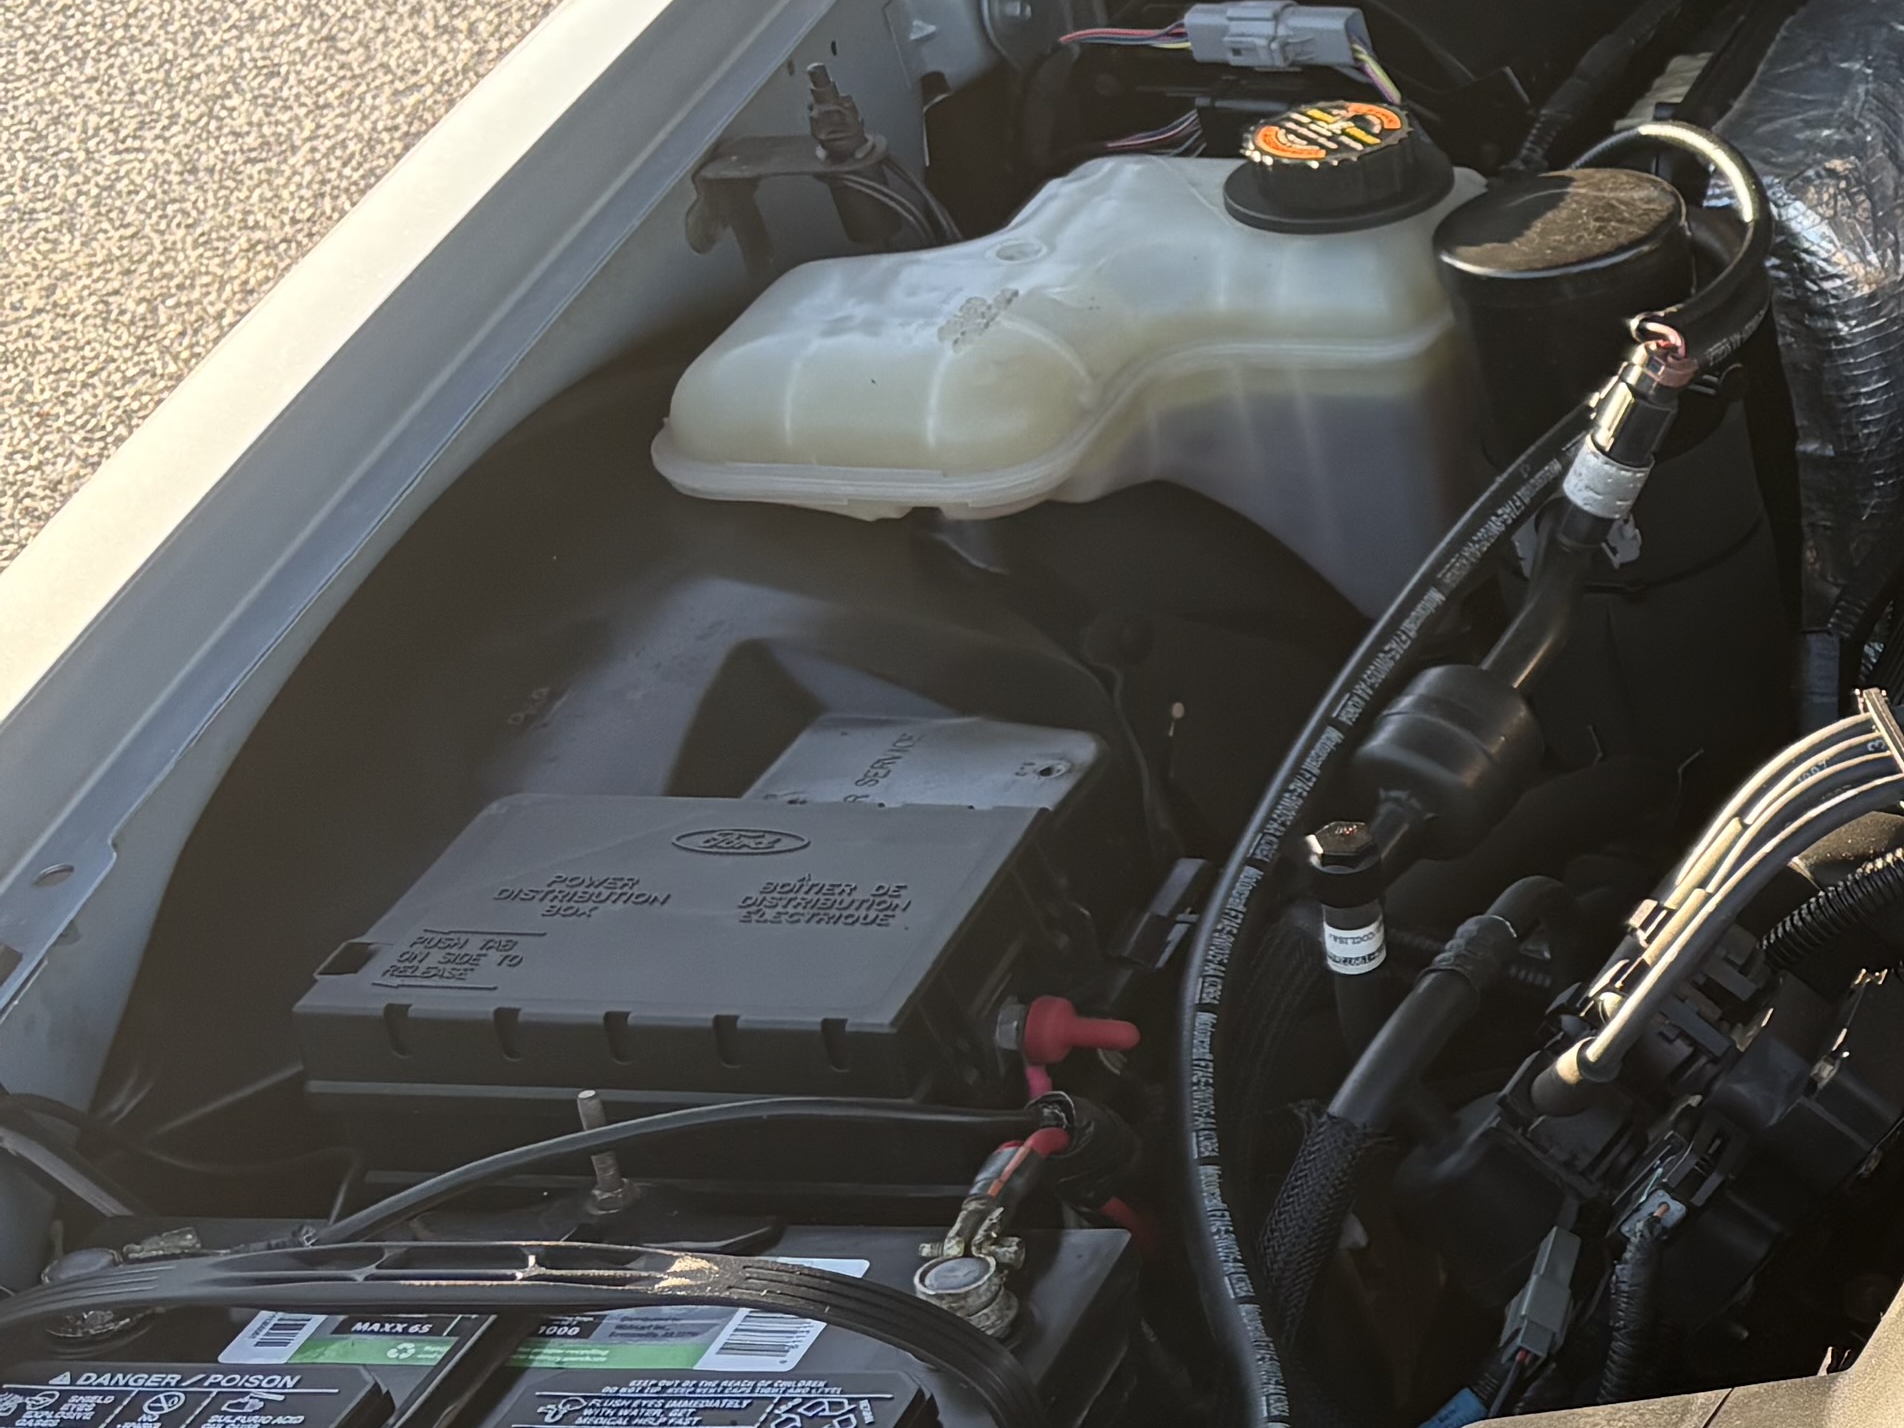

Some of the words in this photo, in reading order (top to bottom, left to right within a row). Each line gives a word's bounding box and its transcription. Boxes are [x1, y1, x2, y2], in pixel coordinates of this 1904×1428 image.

[545, 874, 641, 889] POWER
[491, 887, 673, 907] DISTRIBUTION
[869, 884, 908, 898] DE
[540, 905, 601, 919] BOX
[736, 896, 914, 914] DISTRIBUTION
[408, 935, 470, 950] PUSH
[478, 936, 520, 951] TAB
[396, 950, 426, 965] ON
[437, 951, 489, 967] SIDE
[496, 953, 524, 968] TO
[380, 964, 476, 980] RELEASE
[350, 1320, 406, 1333] MAXX
[537, 1326, 581, 1337] 1000
[76, 1373, 181, 1387] DANGER
[204, 1374, 301, 1388] POISON
